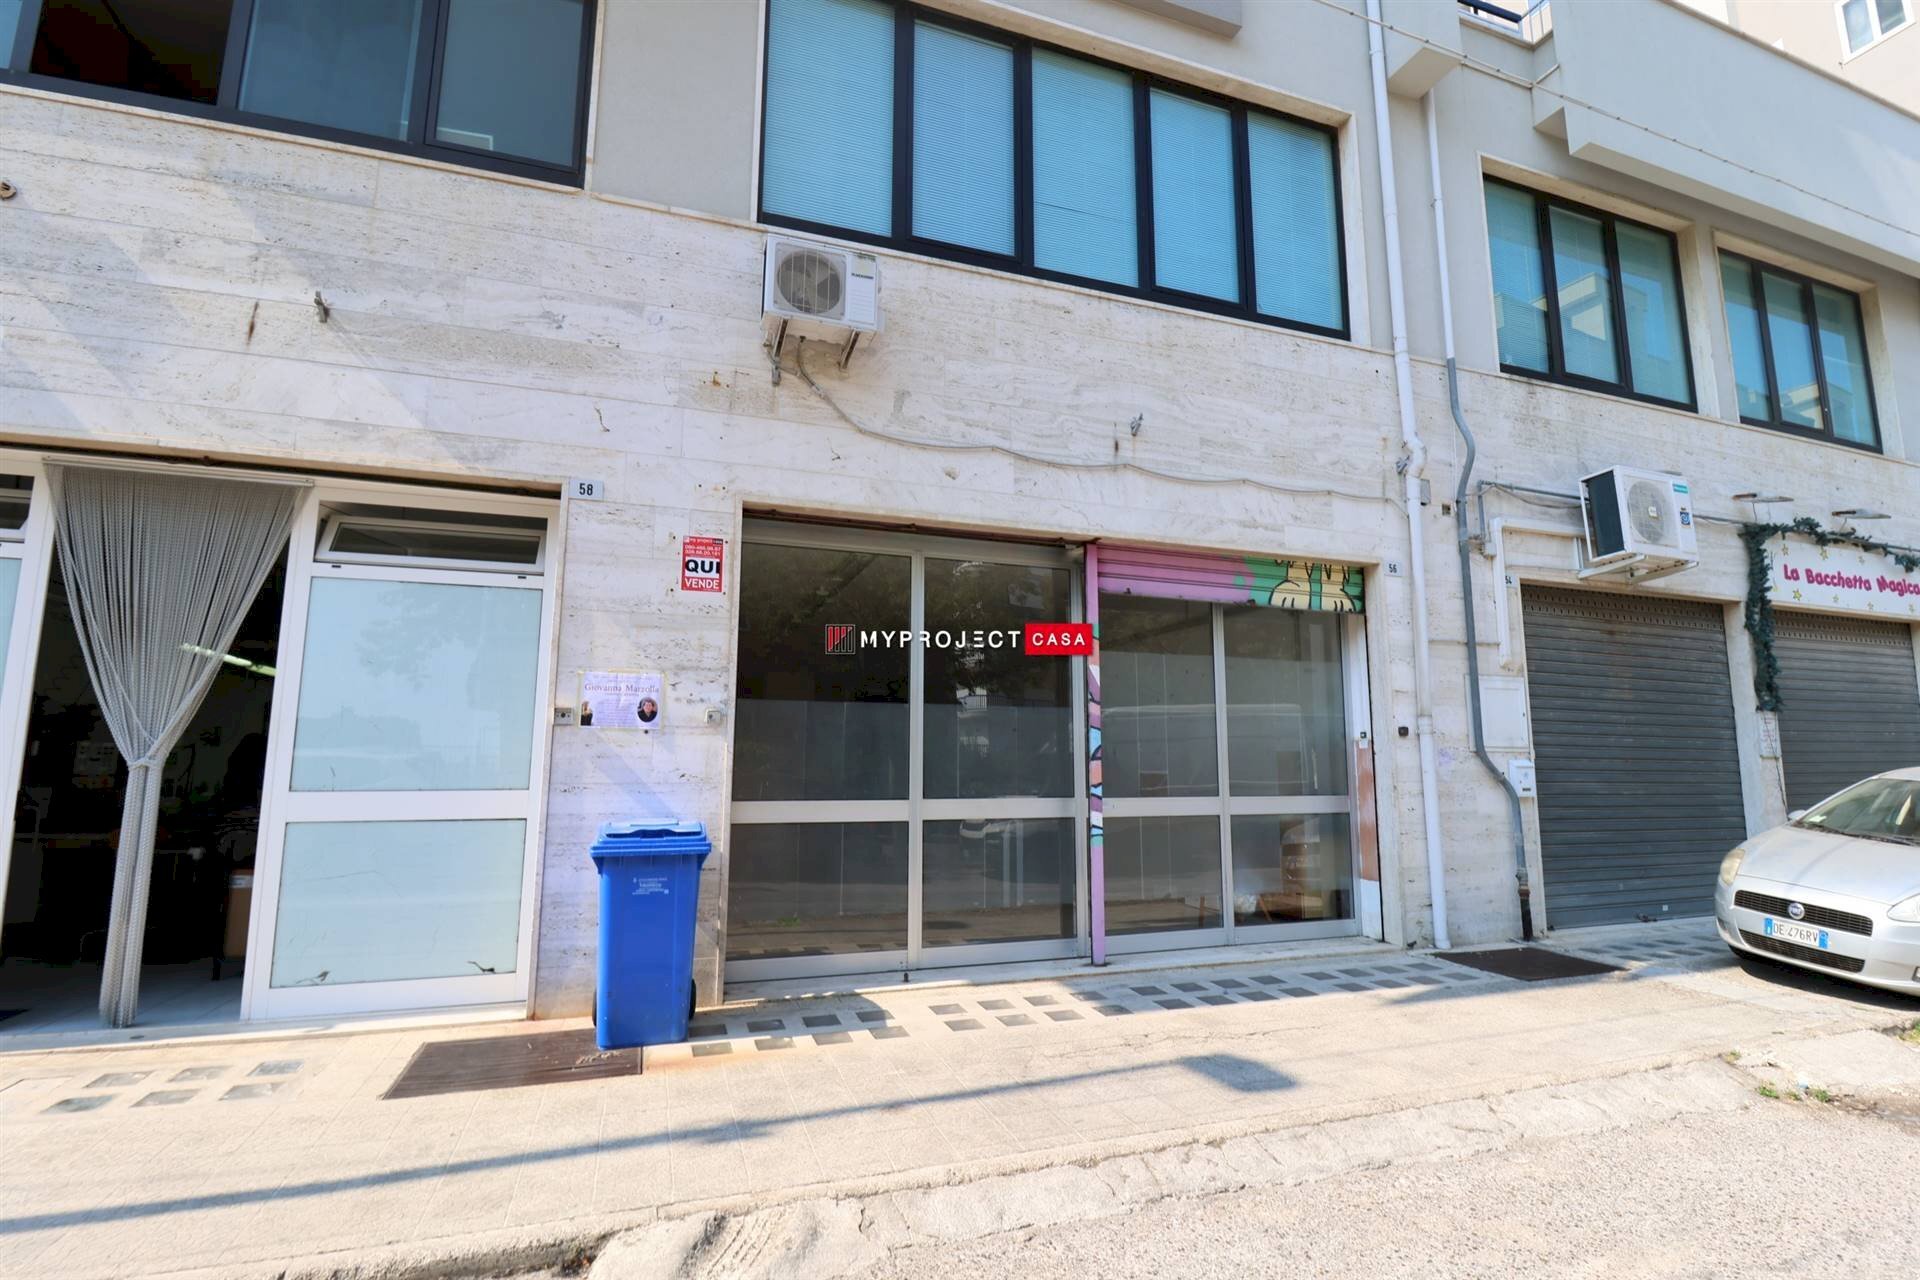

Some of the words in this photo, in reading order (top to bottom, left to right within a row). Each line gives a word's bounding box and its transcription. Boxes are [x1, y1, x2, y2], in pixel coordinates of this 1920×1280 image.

[579, 483, 594, 496] 58
[685, 559, 720, 574] QUI
[1388, 563, 1397, 573] 56
[684, 577, 720, 590] VENDE
[1784, 564, 1800, 581] La
[1805, 568, 1872, 592] Bacchetta
[1876, 575, 1920, 597] Magica
